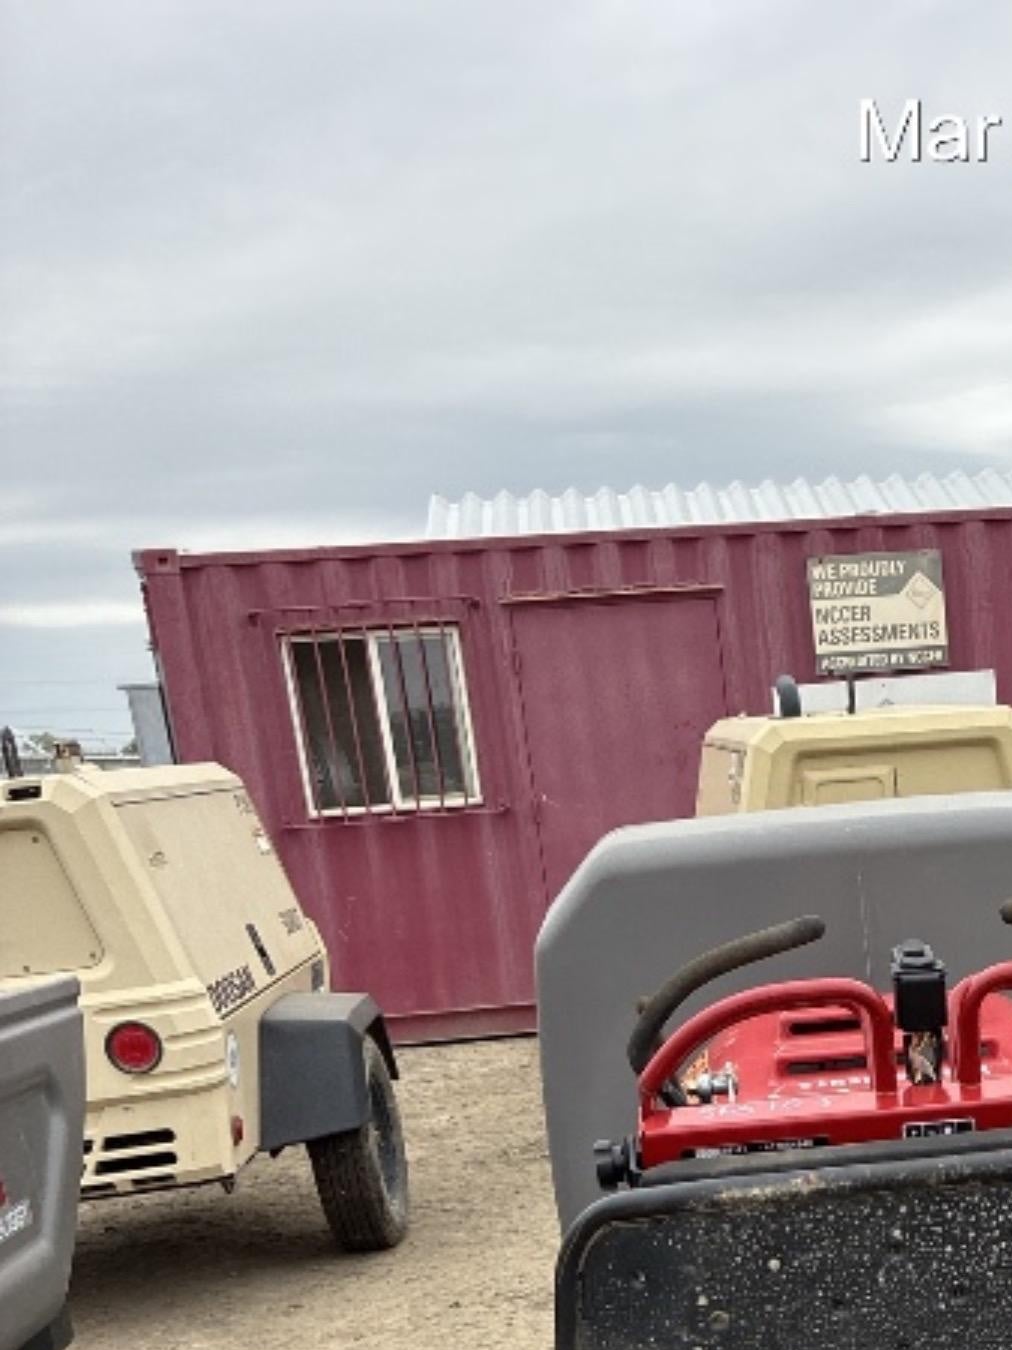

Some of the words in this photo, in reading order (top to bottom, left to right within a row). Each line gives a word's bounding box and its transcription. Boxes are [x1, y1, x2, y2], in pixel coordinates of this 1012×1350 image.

[812, 563, 837, 580] WE
[839, 560, 906, 578] PROUDLY
[815, 578, 878, 598] PROVIDE
[816, 605, 872, 625] NCCER
[818, 620, 940, 646] ASSESSMENTS
